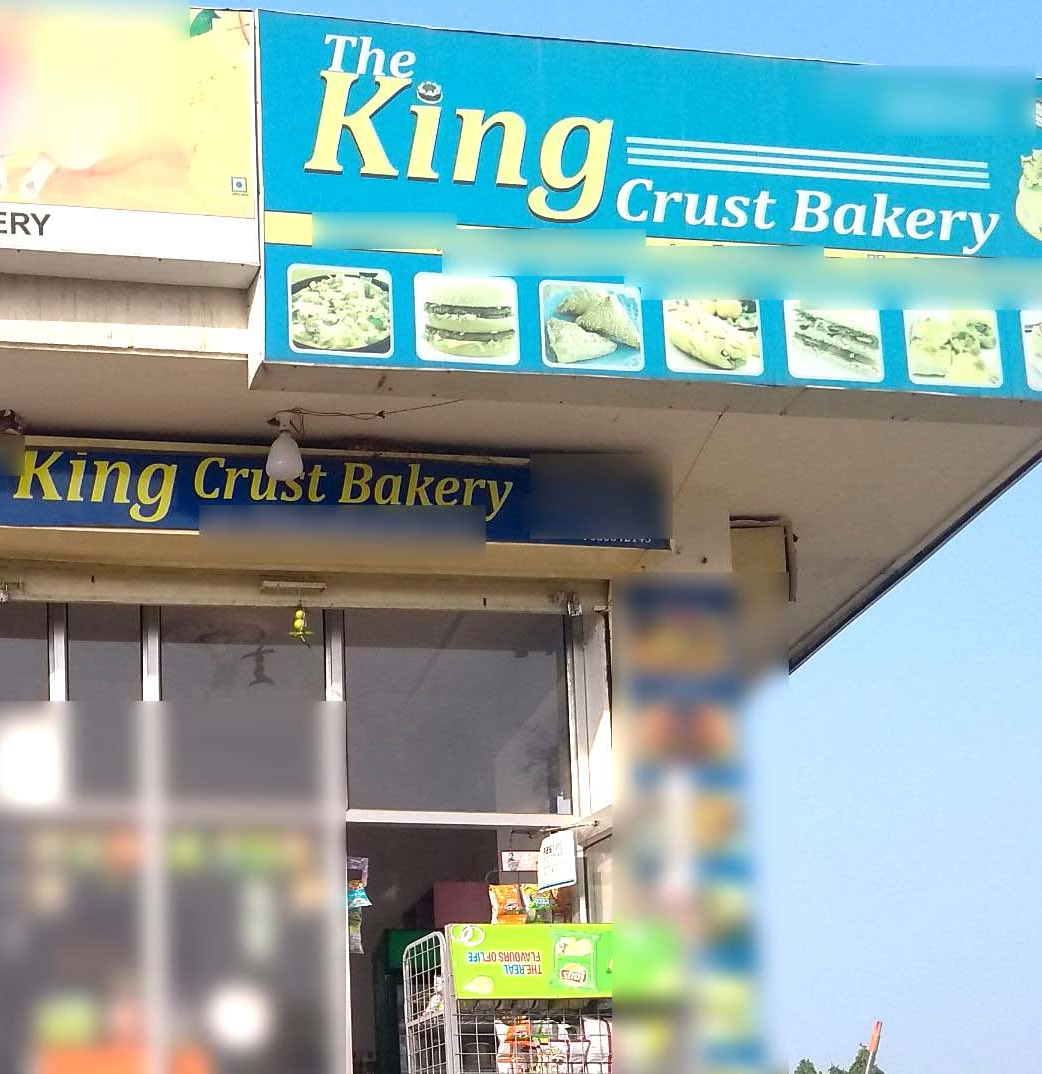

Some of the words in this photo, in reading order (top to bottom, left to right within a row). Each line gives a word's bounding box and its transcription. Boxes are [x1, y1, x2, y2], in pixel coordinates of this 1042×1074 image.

[323, 33, 416, 80] The
[303, 70, 615, 223] King
[615, 177, 778, 232] Crust
[792, 189, 1000, 255] Bakery
[13, 451, 177, 522] King
[338, 462, 514, 522] Bakery
[468, 951, 484, 962] LIFE
[499, 951, 540, 962] FLAVOURS
[503, 964, 525, 975] REAL
